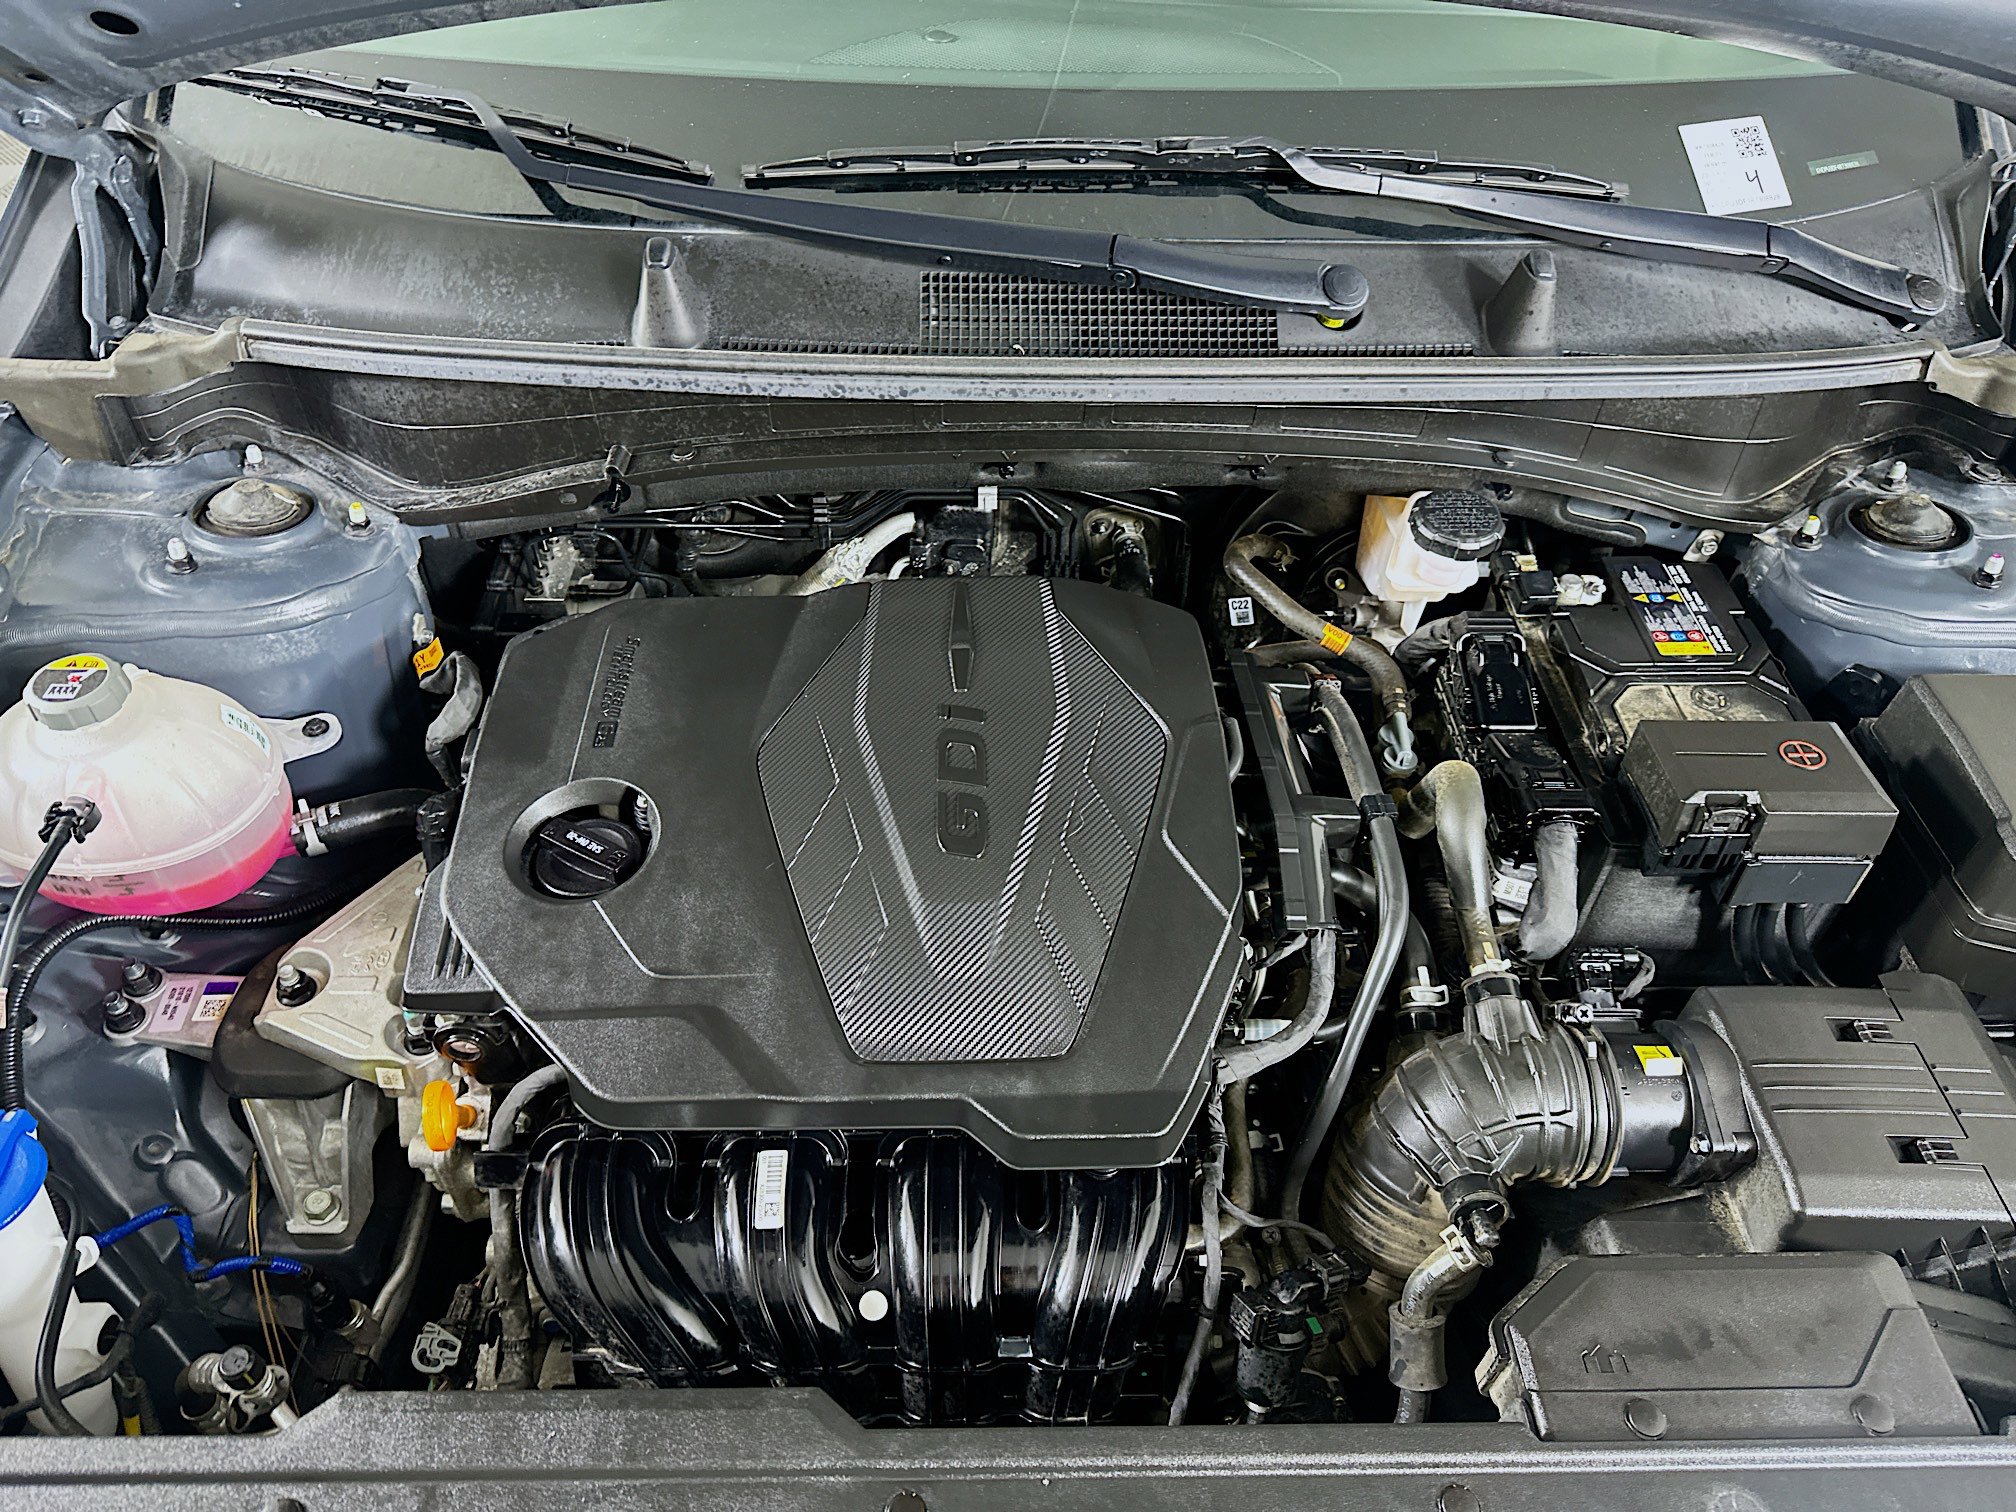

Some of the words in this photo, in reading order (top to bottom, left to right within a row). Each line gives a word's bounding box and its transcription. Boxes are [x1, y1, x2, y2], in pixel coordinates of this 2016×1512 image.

[1744, 169, 1765, 194] 4
[1231, 600, 1249, 610] C22
[609, 635, 641, 719] Smartstream
[936, 704, 988, 859] GDI
[565, 831, 590, 847] 0W-20
[586, 841, 605, 854] SAE
[52, 883, 92, 896] MIN
